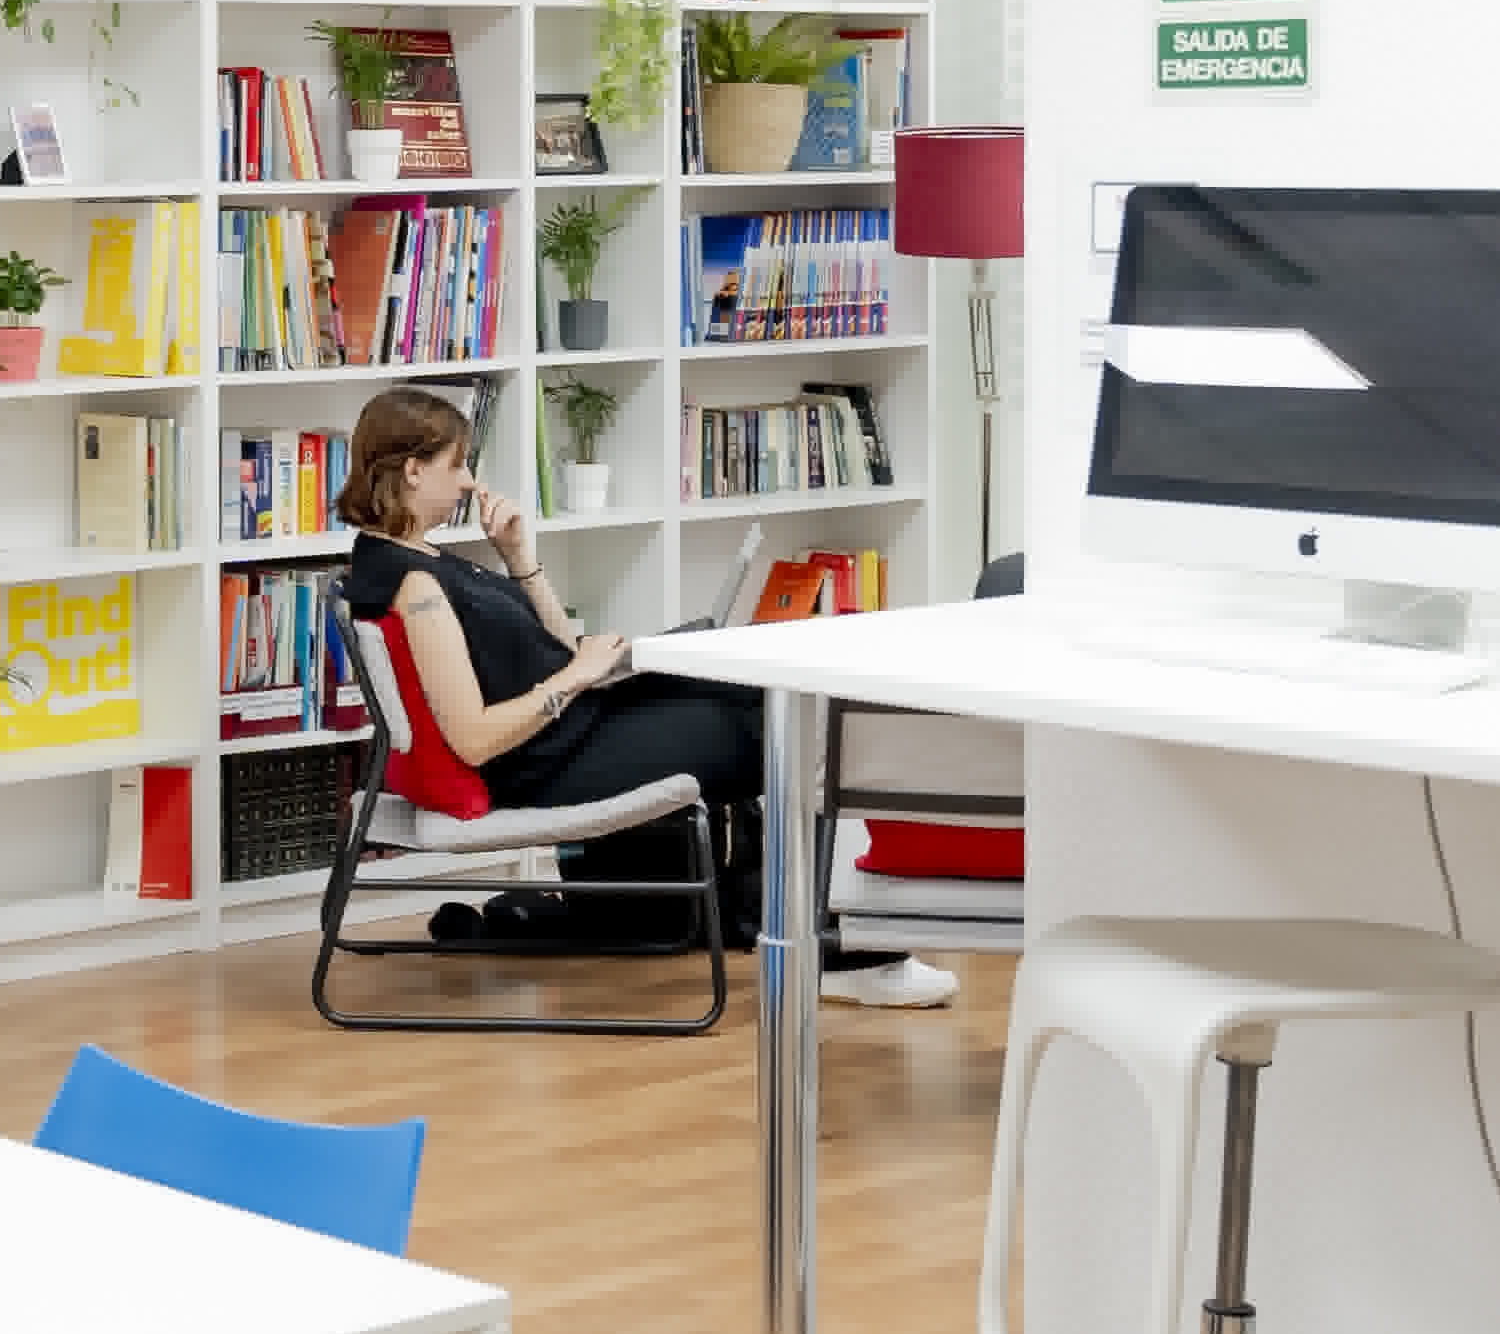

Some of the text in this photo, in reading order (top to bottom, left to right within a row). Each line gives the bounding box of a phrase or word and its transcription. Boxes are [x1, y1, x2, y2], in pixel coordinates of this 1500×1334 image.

[1173, 25, 1289, 52] SALIDA DE
[1160, 55, 1305, 82] EMERGENCIA
[9, 575, 131, 642] Find
